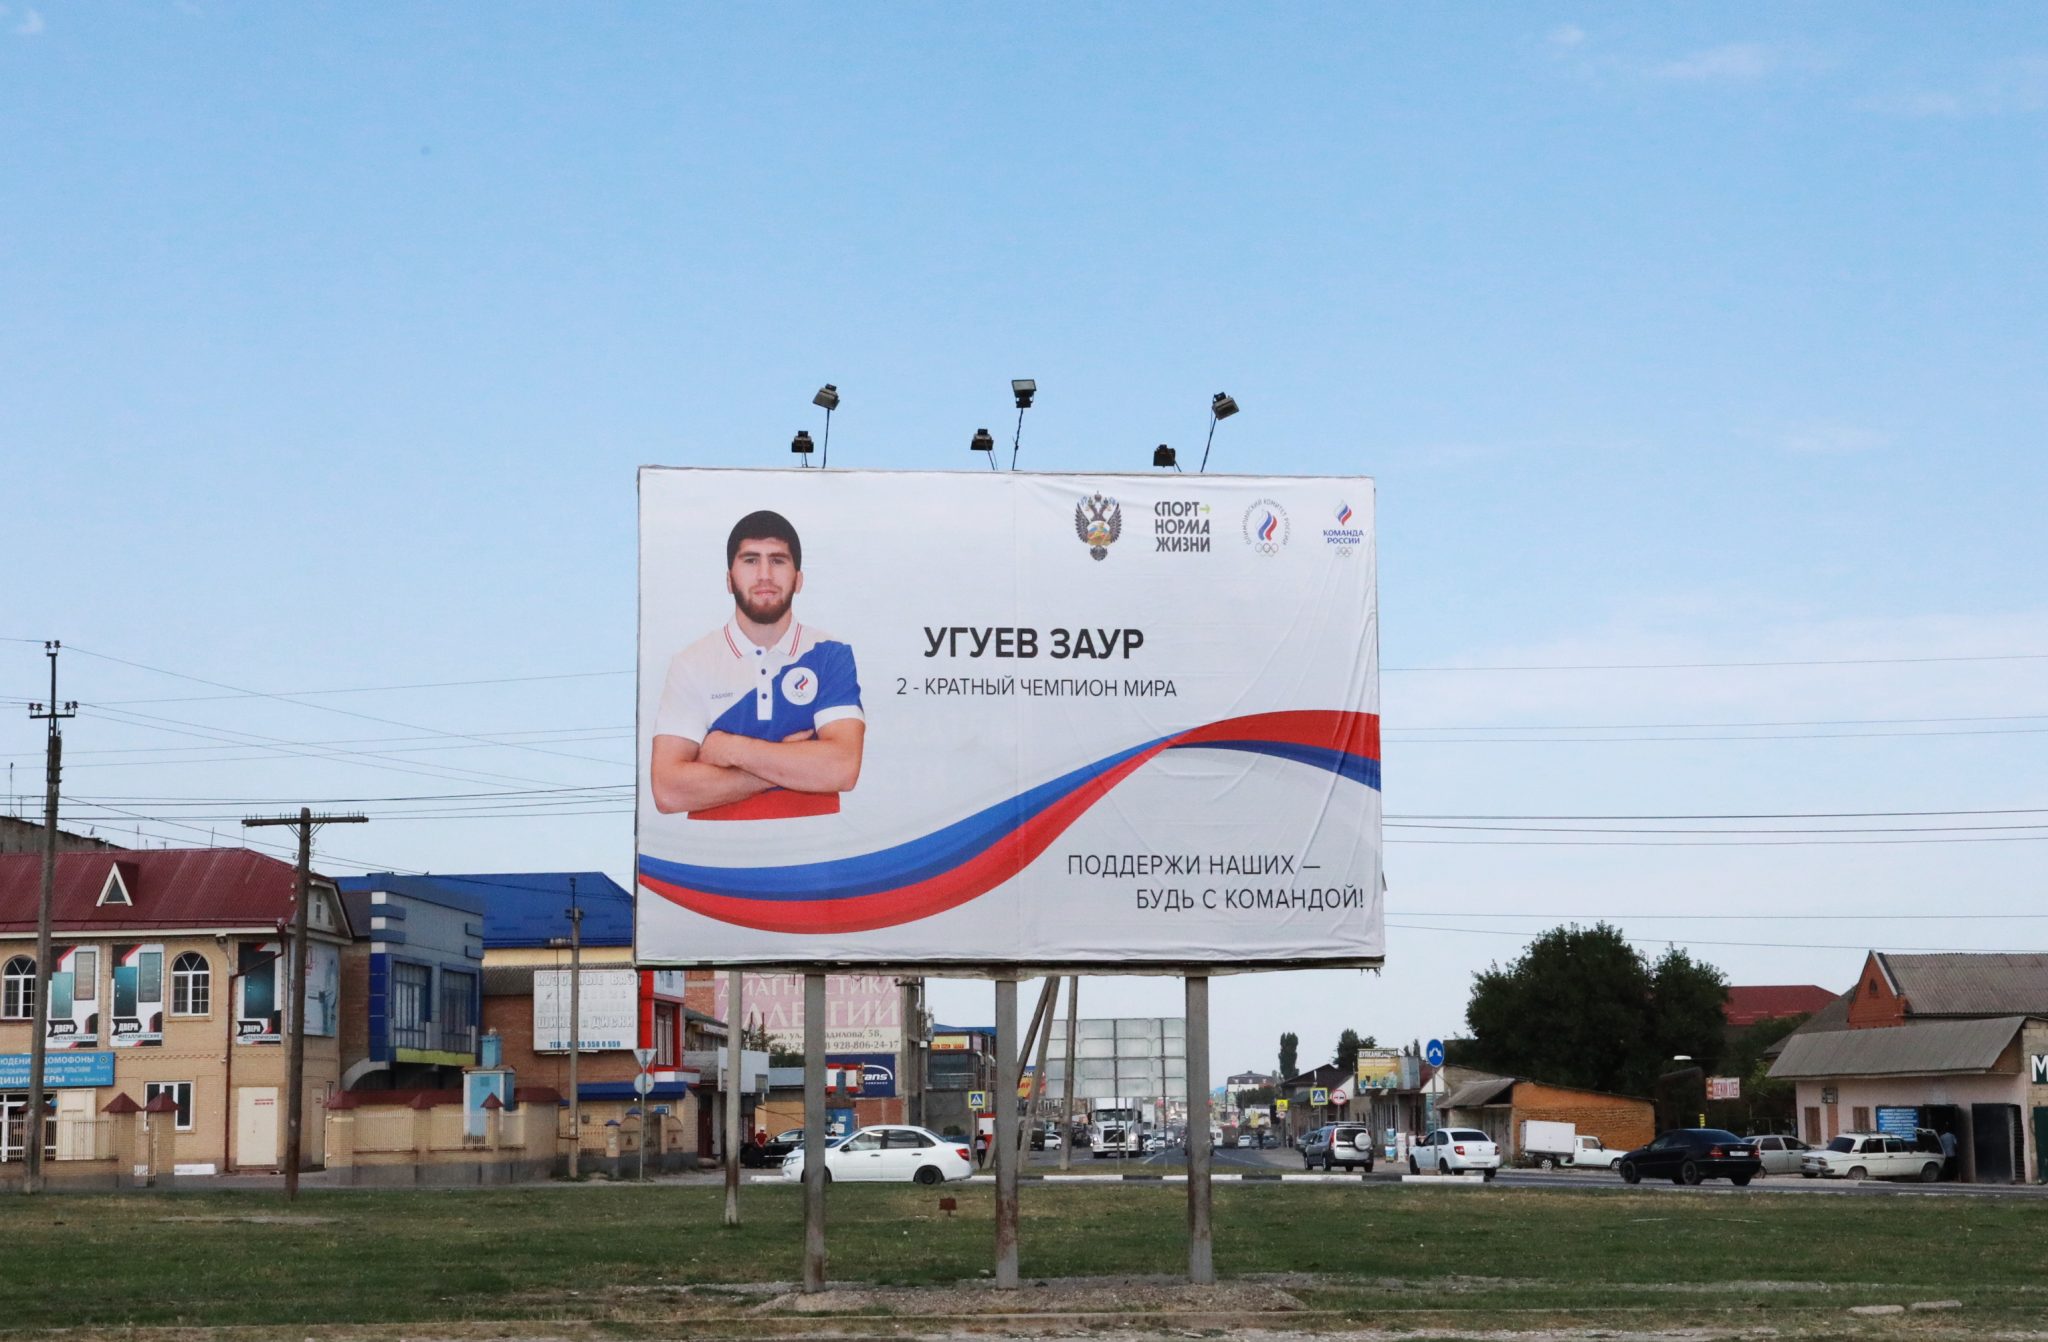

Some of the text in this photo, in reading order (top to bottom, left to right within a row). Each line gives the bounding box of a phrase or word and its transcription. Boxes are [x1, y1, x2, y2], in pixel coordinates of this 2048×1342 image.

[1155, 501, 1200, 516] СПОРТ
[1155, 519, 1210, 534] НОРМА
[1323, 529, 1364, 537] КОМАНДА
[1156, 536, 1210, 552] ЖИЗНИ
[924, 627, 1144, 659] УГУЕВ ЗАУР
[896, 677, 907, 695] 2
[925, 675, 1015, 696] КРАТНЫЙ
[1020, 678, 1118, 697] ЧЕМПИОН
[1124, 680, 1177, 697] МИРА
[1068, 855, 1200, 878] ПОДДЕРЖИ
[1210, 855, 1295, 875] НАШИХ
[1137, 884, 1364, 912] БУДЬ С КОМАНДОЙ!
[54, 1025, 74, 1033] ДВЕРИ
[118, 1023, 139, 1032] ДВЕРИ
[243, 1025, 261, 1033] ДВЕРИ
[44, 1055, 95, 1065] ОМОФОНЫ
